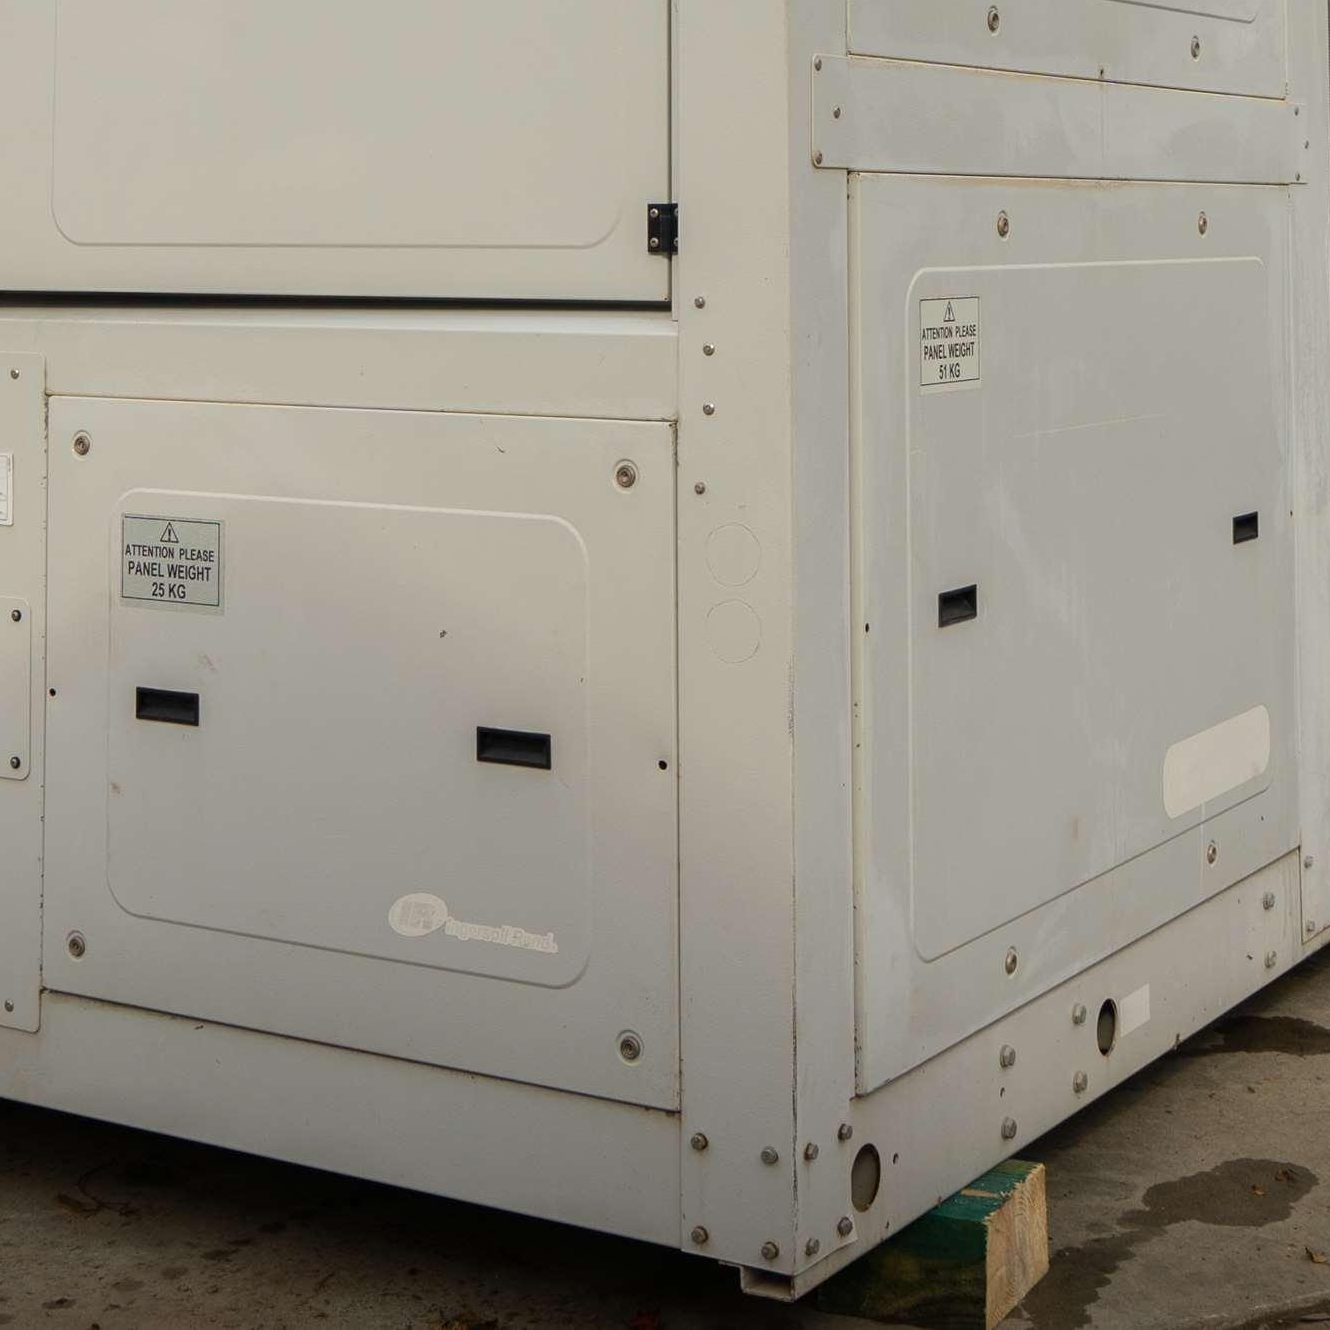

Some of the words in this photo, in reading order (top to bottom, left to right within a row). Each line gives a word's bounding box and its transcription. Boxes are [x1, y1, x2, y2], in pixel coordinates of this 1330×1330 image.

[922, 326, 953, 340] ATTENTION
[955, 324, 977, 338] PLEASE
[923, 344, 947, 360] PANEL
[948, 341, 975, 358] WEIGHT
[939, 364, 947, 379] 51
[949, 362, 961, 379] KG
[125, 543, 175, 559] ATTENTION
[179, 548, 215, 563] PLEASE
[128, 560, 165, 578] PANEL
[167, 563, 212, 582] WEIGHT
[151, 581, 165, 598] 25
[168, 583, 186, 599] KG
